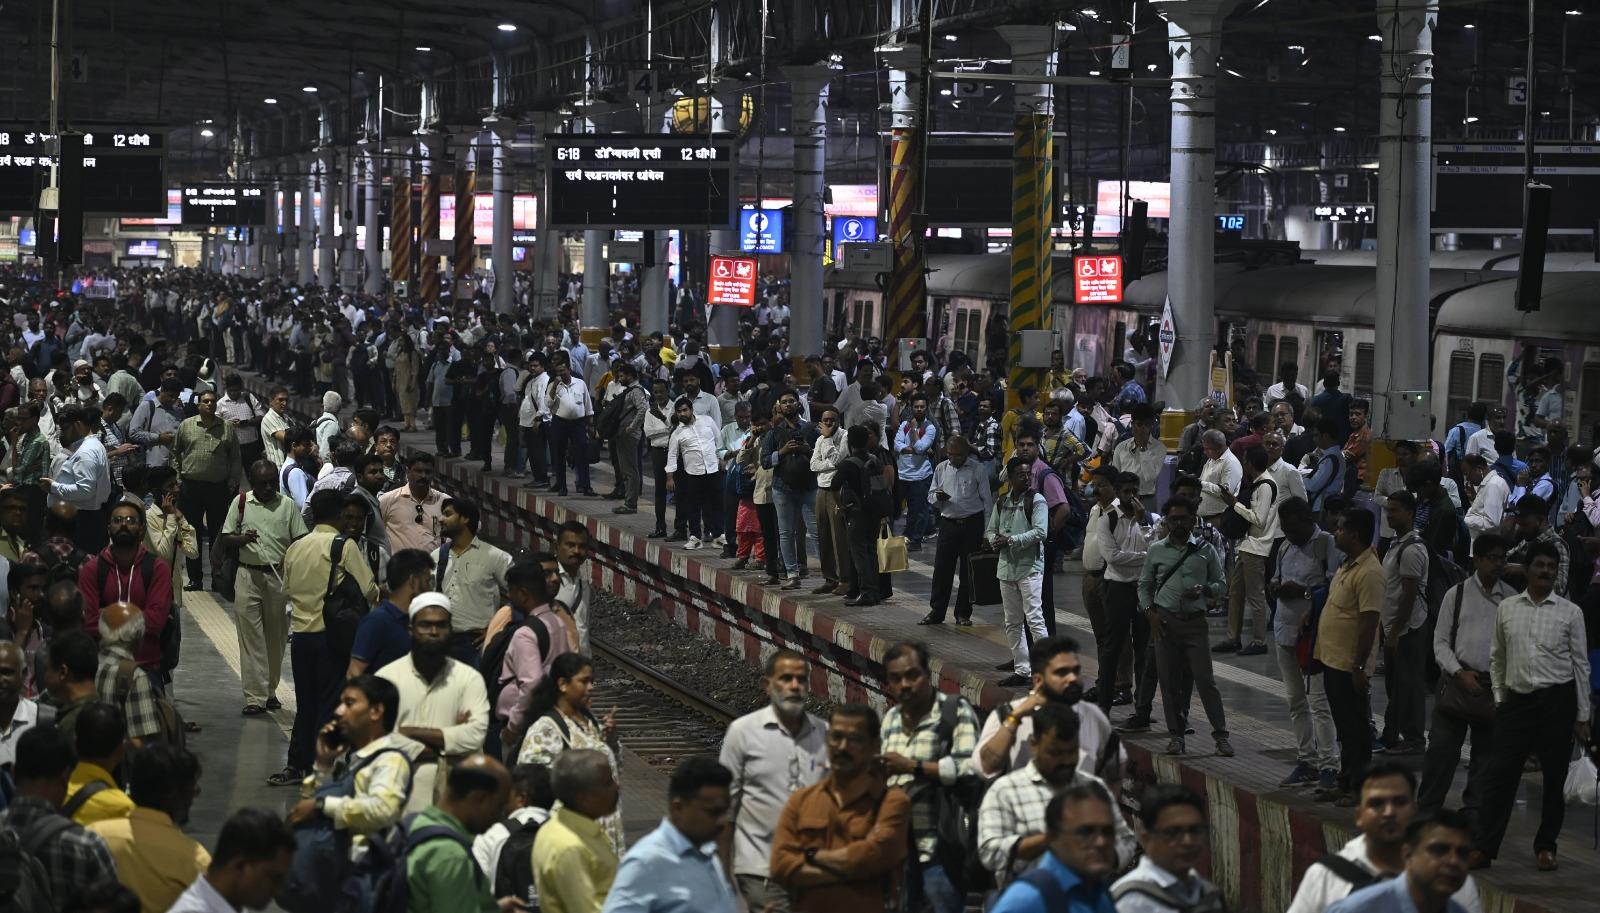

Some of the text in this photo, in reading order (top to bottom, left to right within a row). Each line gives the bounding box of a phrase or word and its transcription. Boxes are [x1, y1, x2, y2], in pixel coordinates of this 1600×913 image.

[634, 74, 653, 94] 4
[1514, 81, 1527, 102] 3
[113, 135, 126, 146] 12
[558, 147, 580, 161] 6:18
[681, 147, 693, 161] 12
[565, 168, 582, 181] सर्व
